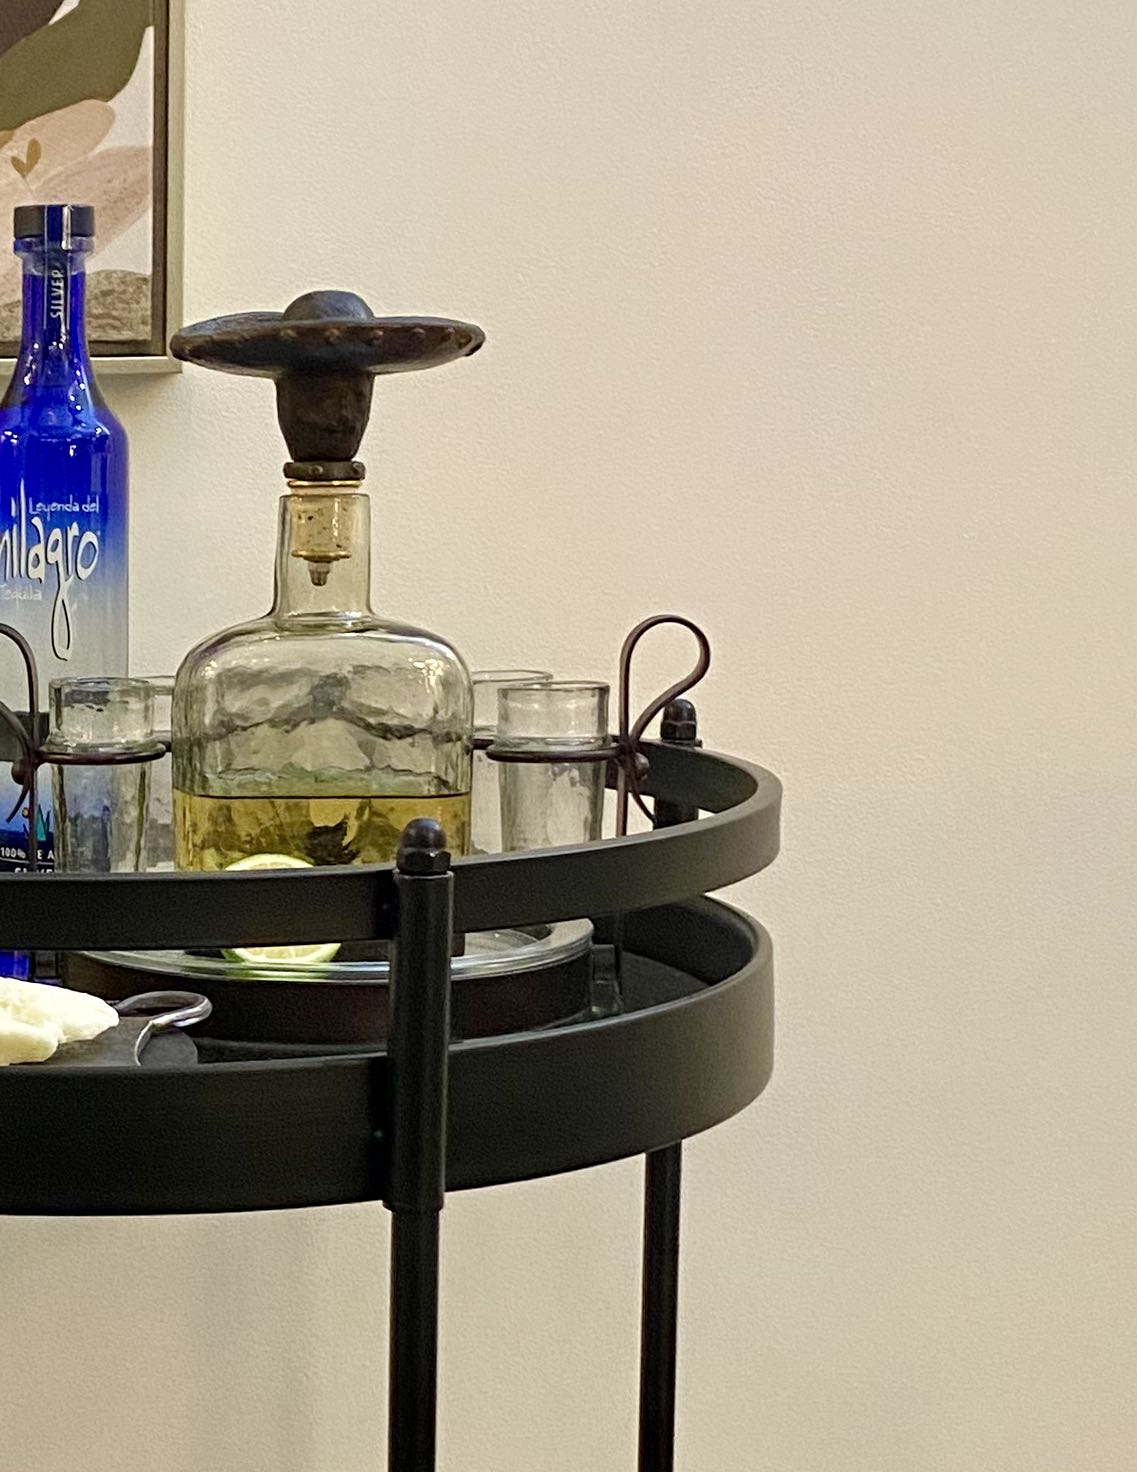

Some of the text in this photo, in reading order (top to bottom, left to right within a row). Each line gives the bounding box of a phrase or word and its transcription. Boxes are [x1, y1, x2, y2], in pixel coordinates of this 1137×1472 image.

[50, 269, 64, 319] SILVER
[29, 495, 100, 520] Leyenda del
[0, 847, 27, 858] 100%
